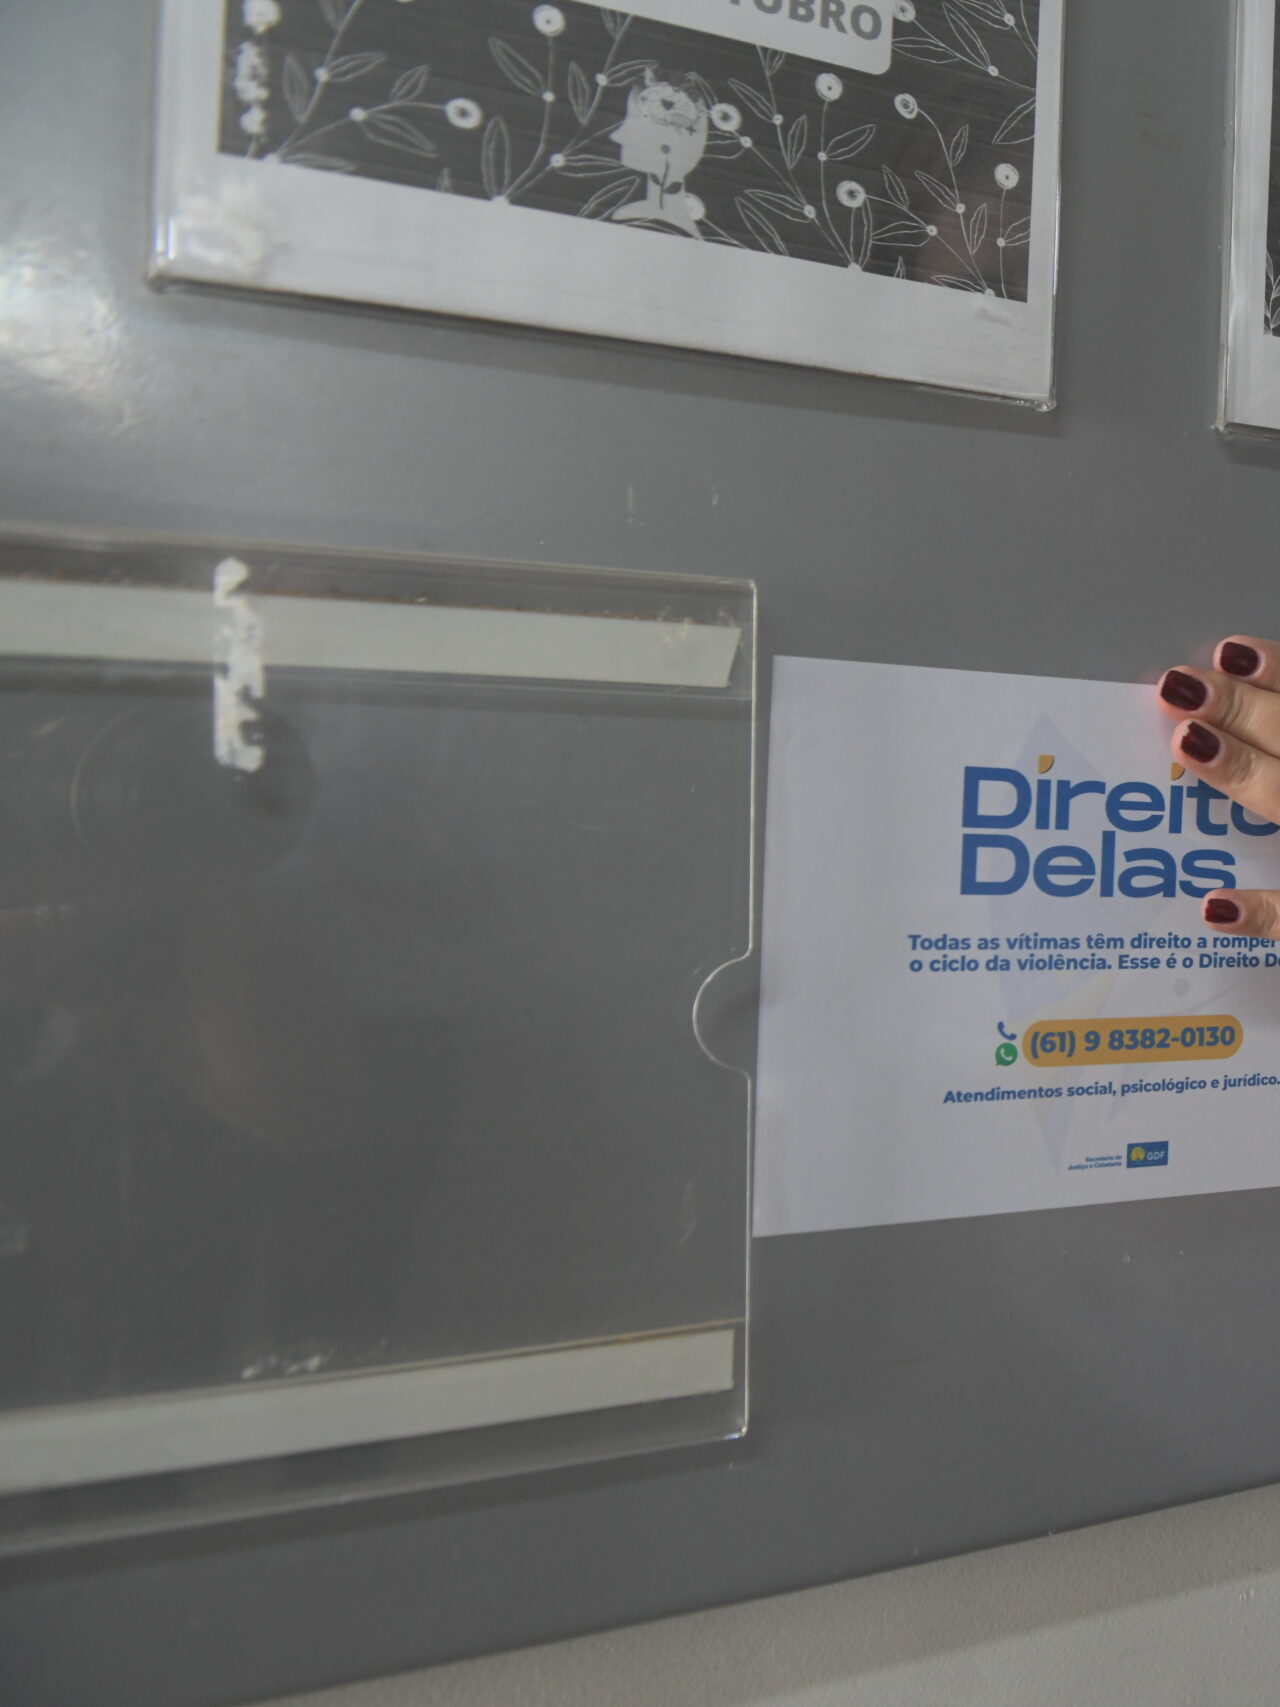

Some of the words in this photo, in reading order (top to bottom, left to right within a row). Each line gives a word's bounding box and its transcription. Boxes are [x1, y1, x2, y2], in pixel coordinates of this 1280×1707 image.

[729, 0, 883, 41] BRO
[960, 830, 1237, 899] Delas
[907, 934, 971, 951] Todas
[977, 937, 1000, 951] as
[1006, 932, 1080, 950] vítimas
[1086, 933, 1124, 949] têm
[1130, 932, 1192, 949] direito
[1197, 936, 1207, 949] a
[1212, 935, 1275, 951] romper
[909, 959, 923, 972] o
[929, 954, 979, 972] ciclo
[985, 955, 1010, 971] da
[1017, 953, 1112, 971] violência.
[1118, 954, 1161, 969] Esse
[1166, 952, 1177, 969] é
[1182, 956, 1194, 969] o
[1199, 952, 1260, 969] Direito
[1030, 1030, 1076, 1059] (61)
[1084, 1031, 1101, 1051] 9
[1108, 1025, 1236, 1050] 8382-0130
[943, 1086, 1063, 1104] Atendimentos
[1067, 1081, 1117, 1098] social,
[1121, 1076, 1207, 1097] psicológico
[1211, 1079, 1220, 1089] e
[1222, 1073, 1280, 1091] jurídico.
[1147, 1151, 1165, 1160] GDF
